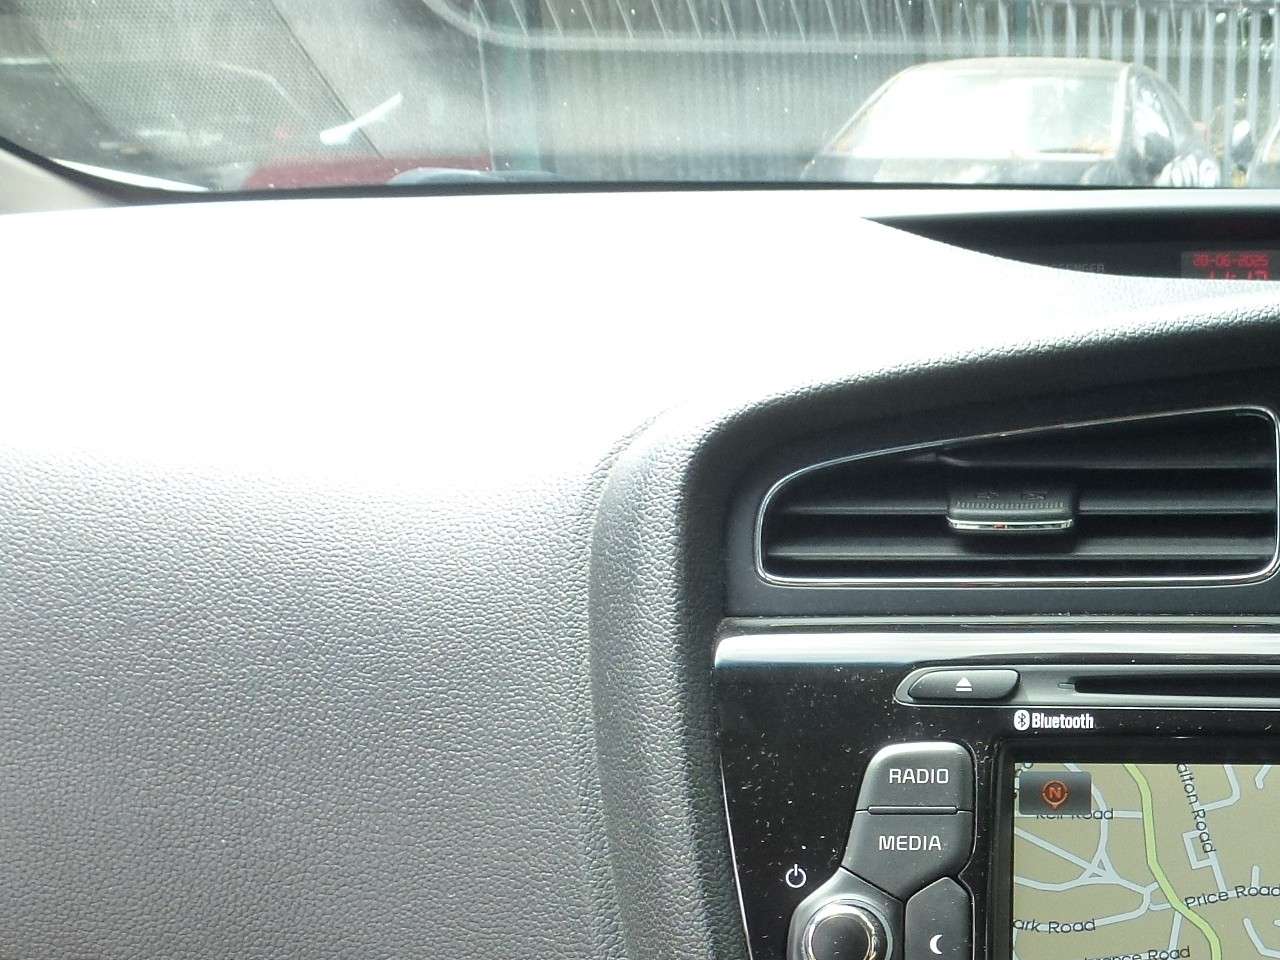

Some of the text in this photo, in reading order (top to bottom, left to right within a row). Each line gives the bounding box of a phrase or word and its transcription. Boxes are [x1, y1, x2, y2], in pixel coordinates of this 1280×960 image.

[1031, 712, 1094, 729] Bluetooth
[889, 768, 949, 784] RADIO
[1192, 808, 1217, 853] Road
[879, 835, 942, 851] MEDIA
[1184, 891, 1230, 909] Price
[1049, 918, 1096, 934] Road
